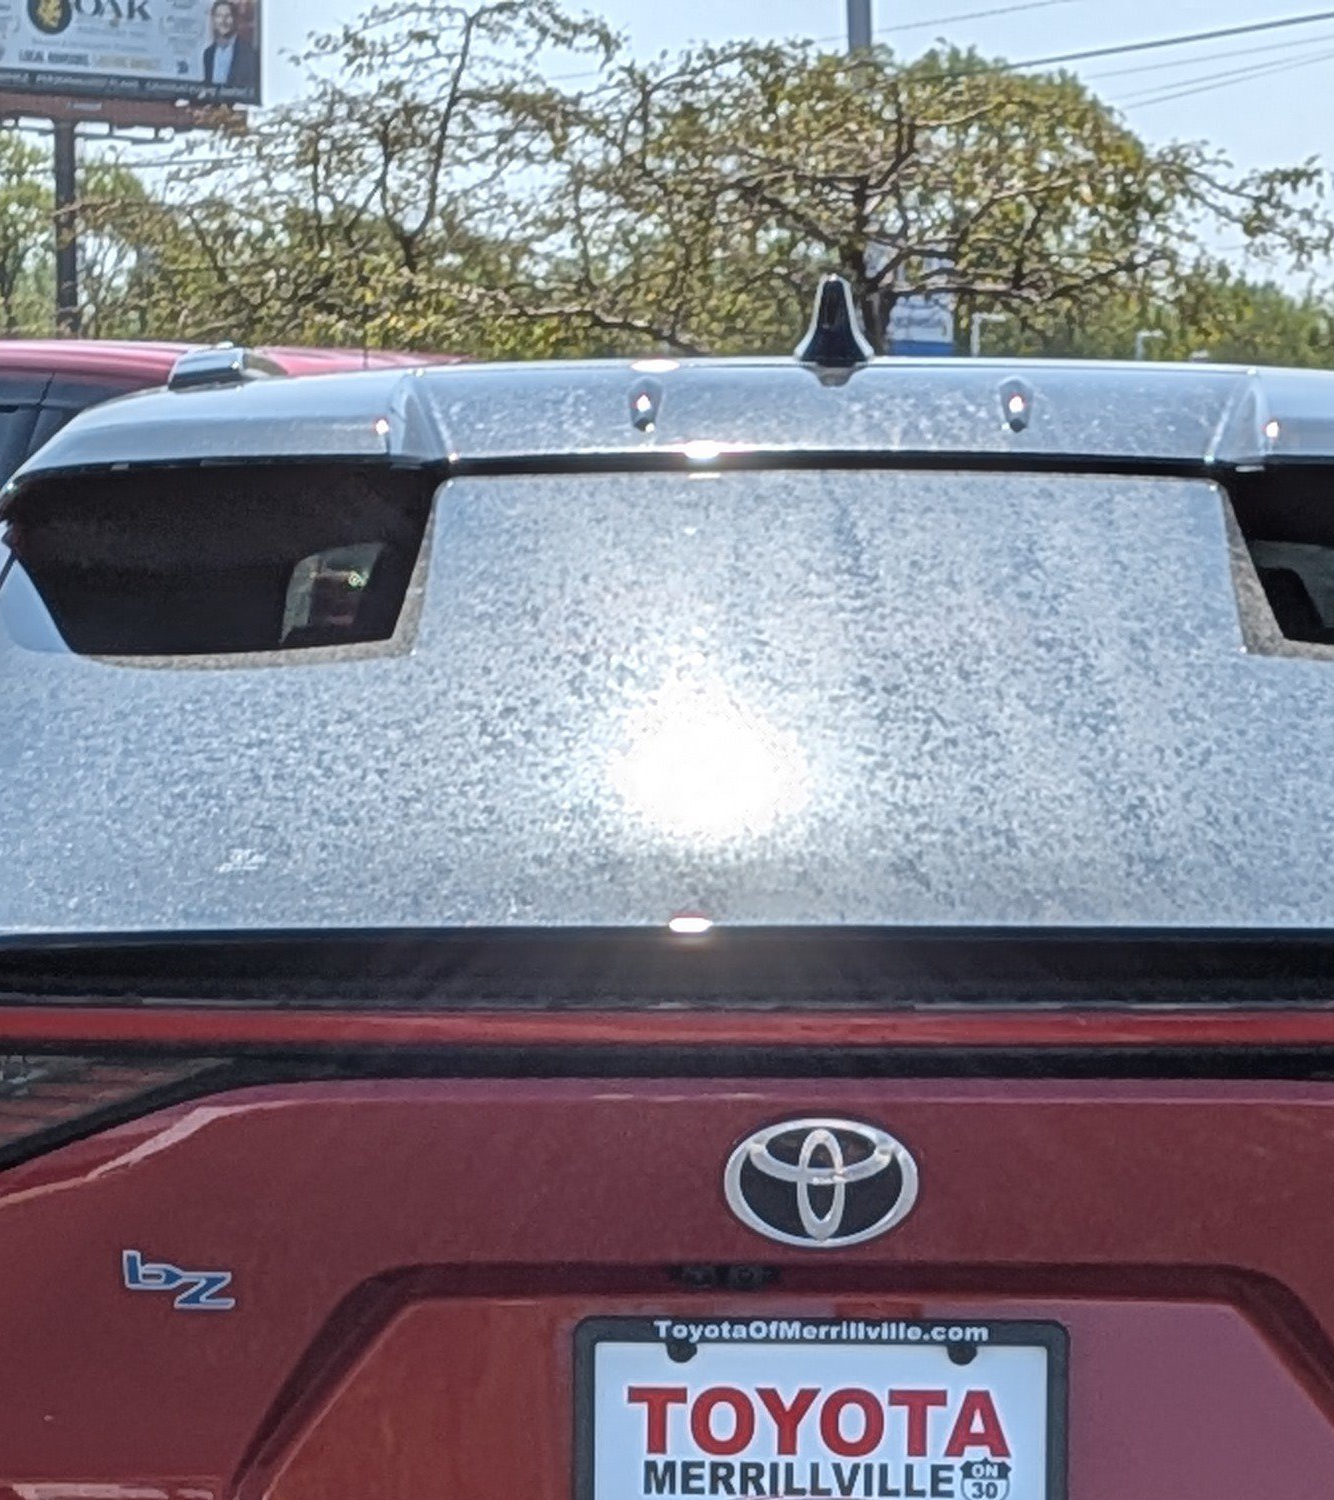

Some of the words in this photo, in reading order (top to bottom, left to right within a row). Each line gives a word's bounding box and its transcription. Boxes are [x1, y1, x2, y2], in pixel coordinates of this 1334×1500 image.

[654, 1320, 989, 1343] ToyotaOfMerrillville.com
[627, 1386, 1011, 1457] TOYOTA
[643, 1460, 955, 1499] MERRILLVILLE
[970, 1464, 999, 1479] ON
[971, 1482, 999, 1499] 30
